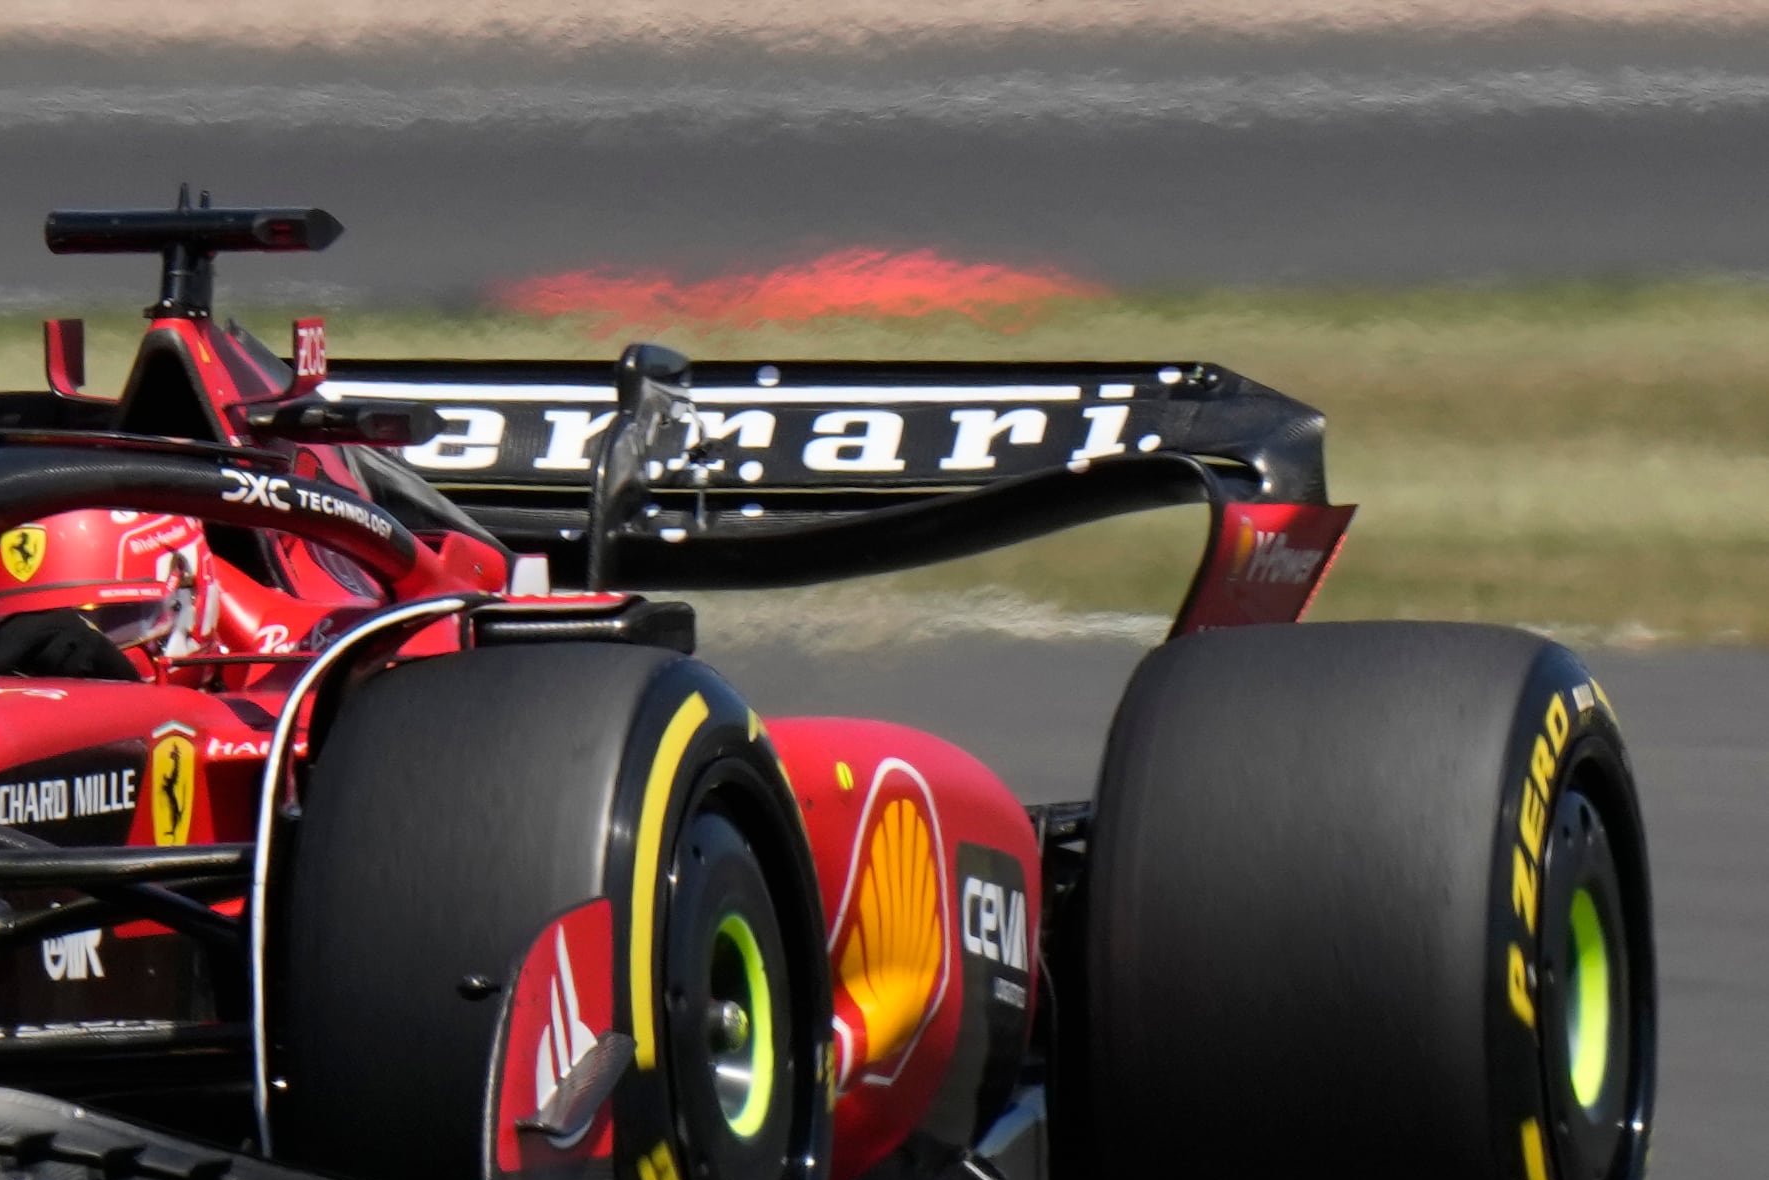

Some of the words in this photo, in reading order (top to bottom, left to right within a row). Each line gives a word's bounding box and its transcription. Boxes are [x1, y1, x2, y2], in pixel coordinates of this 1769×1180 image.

[221, 468, 292, 511] DXC
[296, 489, 393, 541] TECHNOLOGY
[74, 769, 136, 818] MILLE
[1512, 692, 1569, 936] ZERO
[1508, 941, 1536, 1029] P
